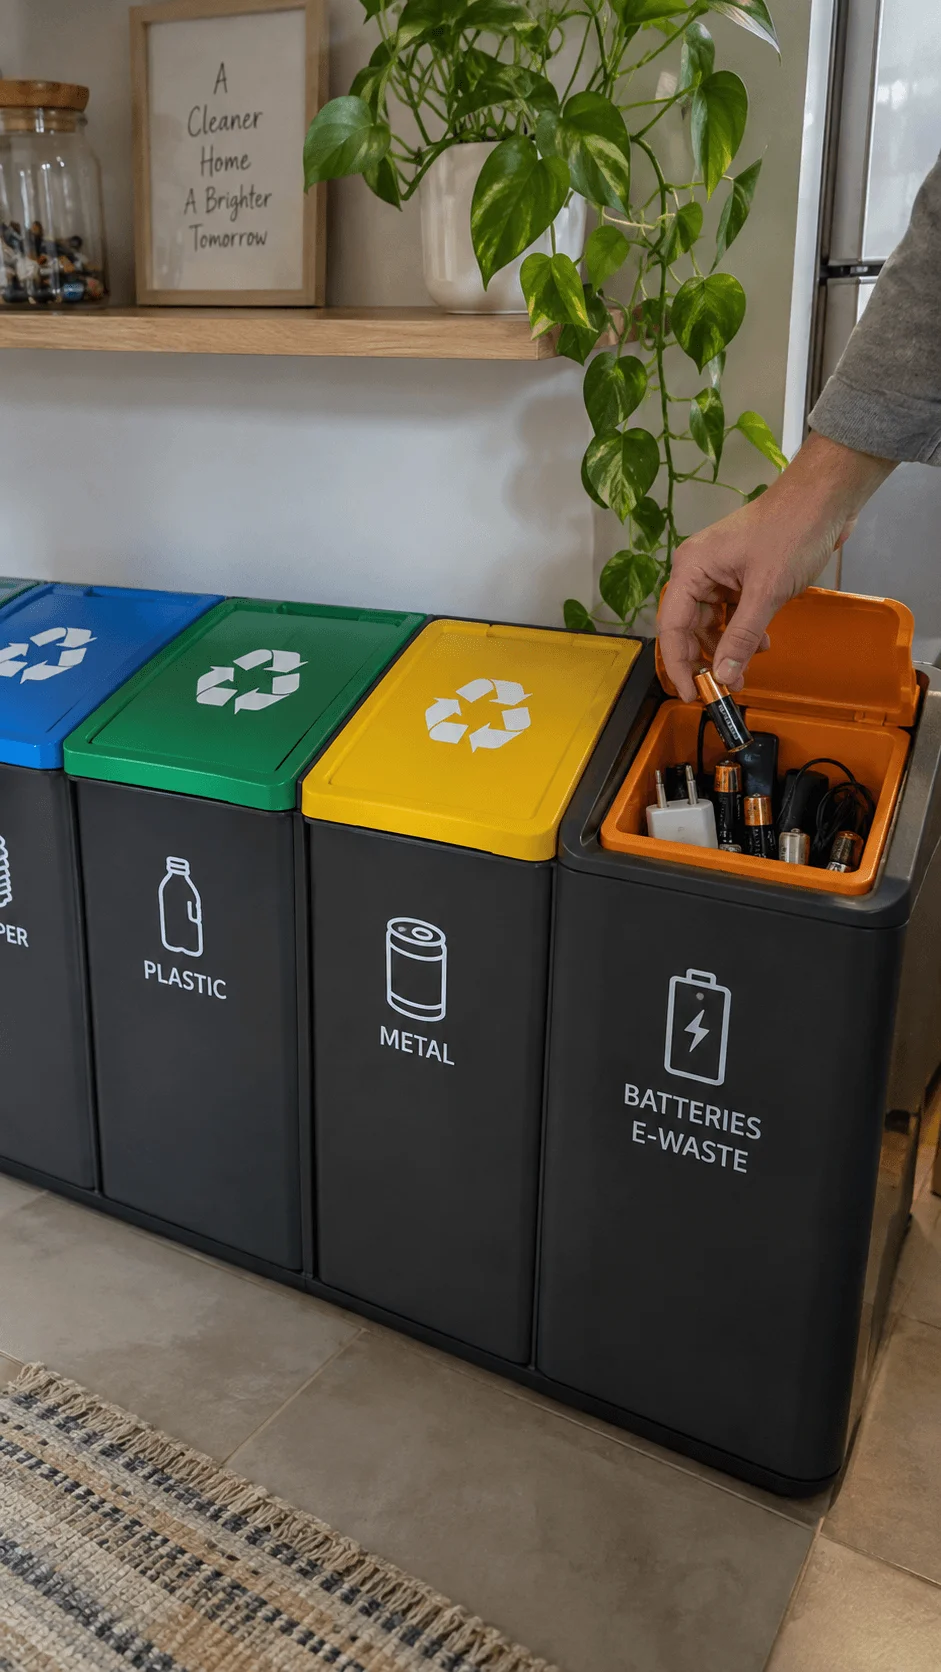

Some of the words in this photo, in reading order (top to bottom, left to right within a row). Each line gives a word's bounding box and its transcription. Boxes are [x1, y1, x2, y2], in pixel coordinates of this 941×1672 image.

[213, 61, 228, 95] A
[187, 104, 263, 138] Cleaner
[199, 145, 251, 178] Home
[183, 187, 197, 216] A
[204, 183, 273, 222] Brighter
[188, 223, 268, 252] Tomorrow
[143, 960, 227, 1000] PLASTIC
[380, 1025, 455, 1066] METAL
[624, 1083, 762, 1140] BATTERIES
[632, 1120, 749, 1174] E-WASTE
